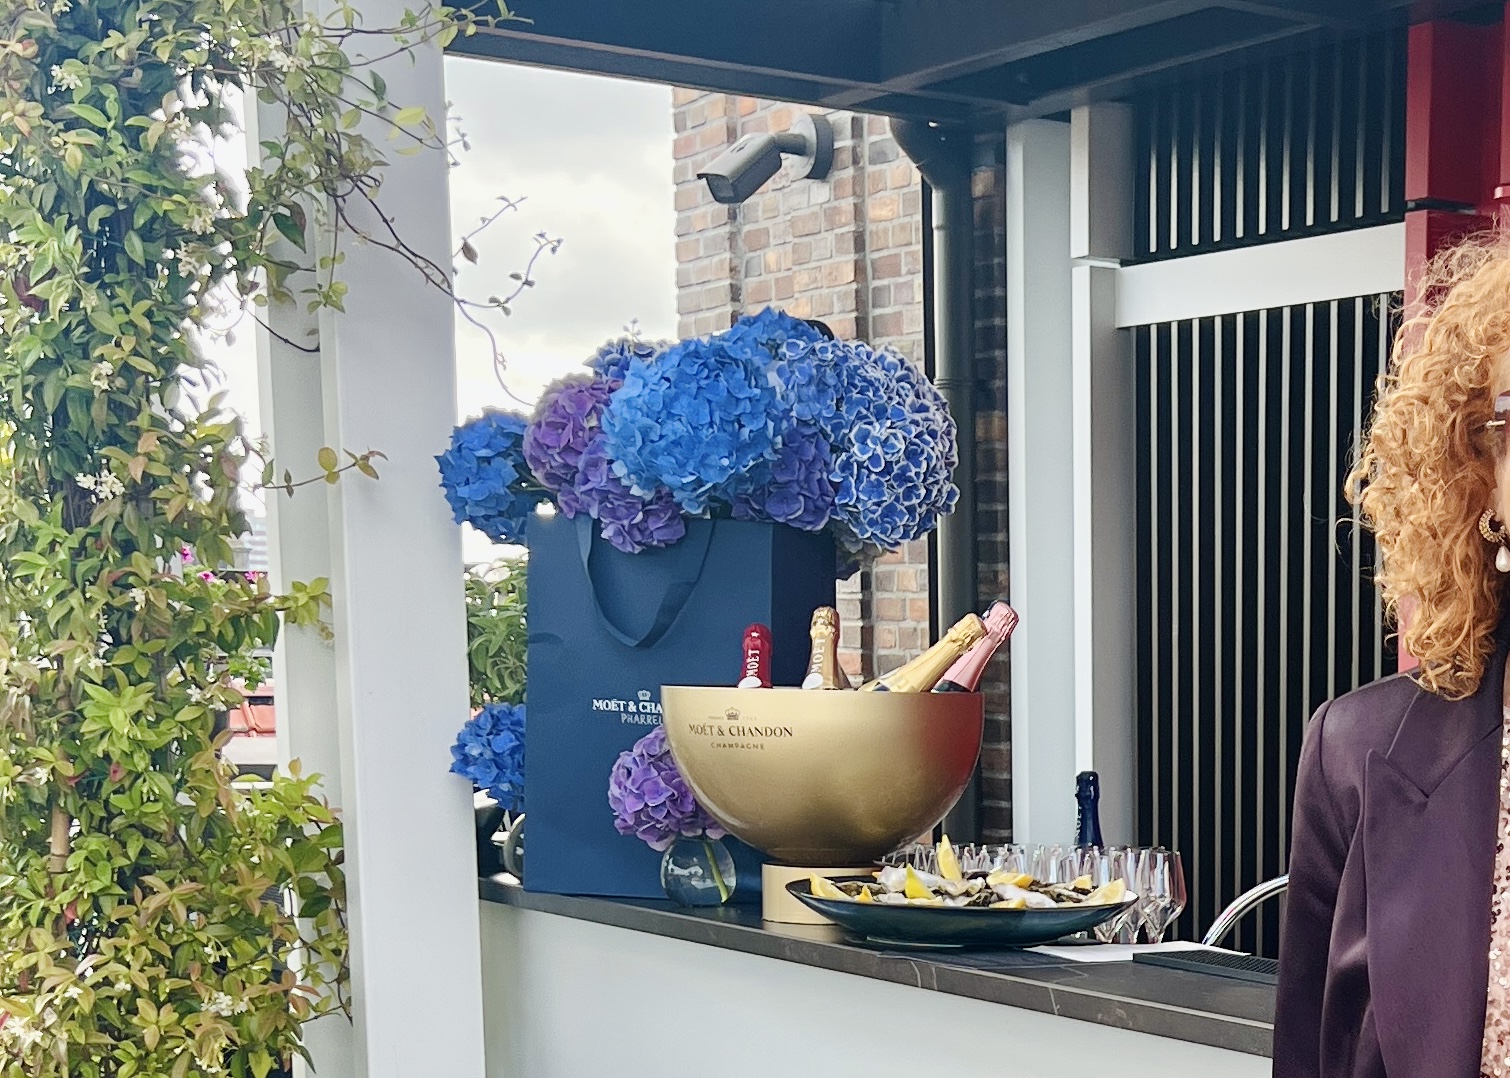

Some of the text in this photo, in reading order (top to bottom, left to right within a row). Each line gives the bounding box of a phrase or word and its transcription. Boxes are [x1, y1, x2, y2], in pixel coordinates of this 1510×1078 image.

[627, 701, 637, 712] &
[621, 713, 664, 725] PHARREL
[717, 725, 725, 737] &
[728, 725, 793, 738] CHANDON
[710, 742, 764, 750] CHAMPAGNE
